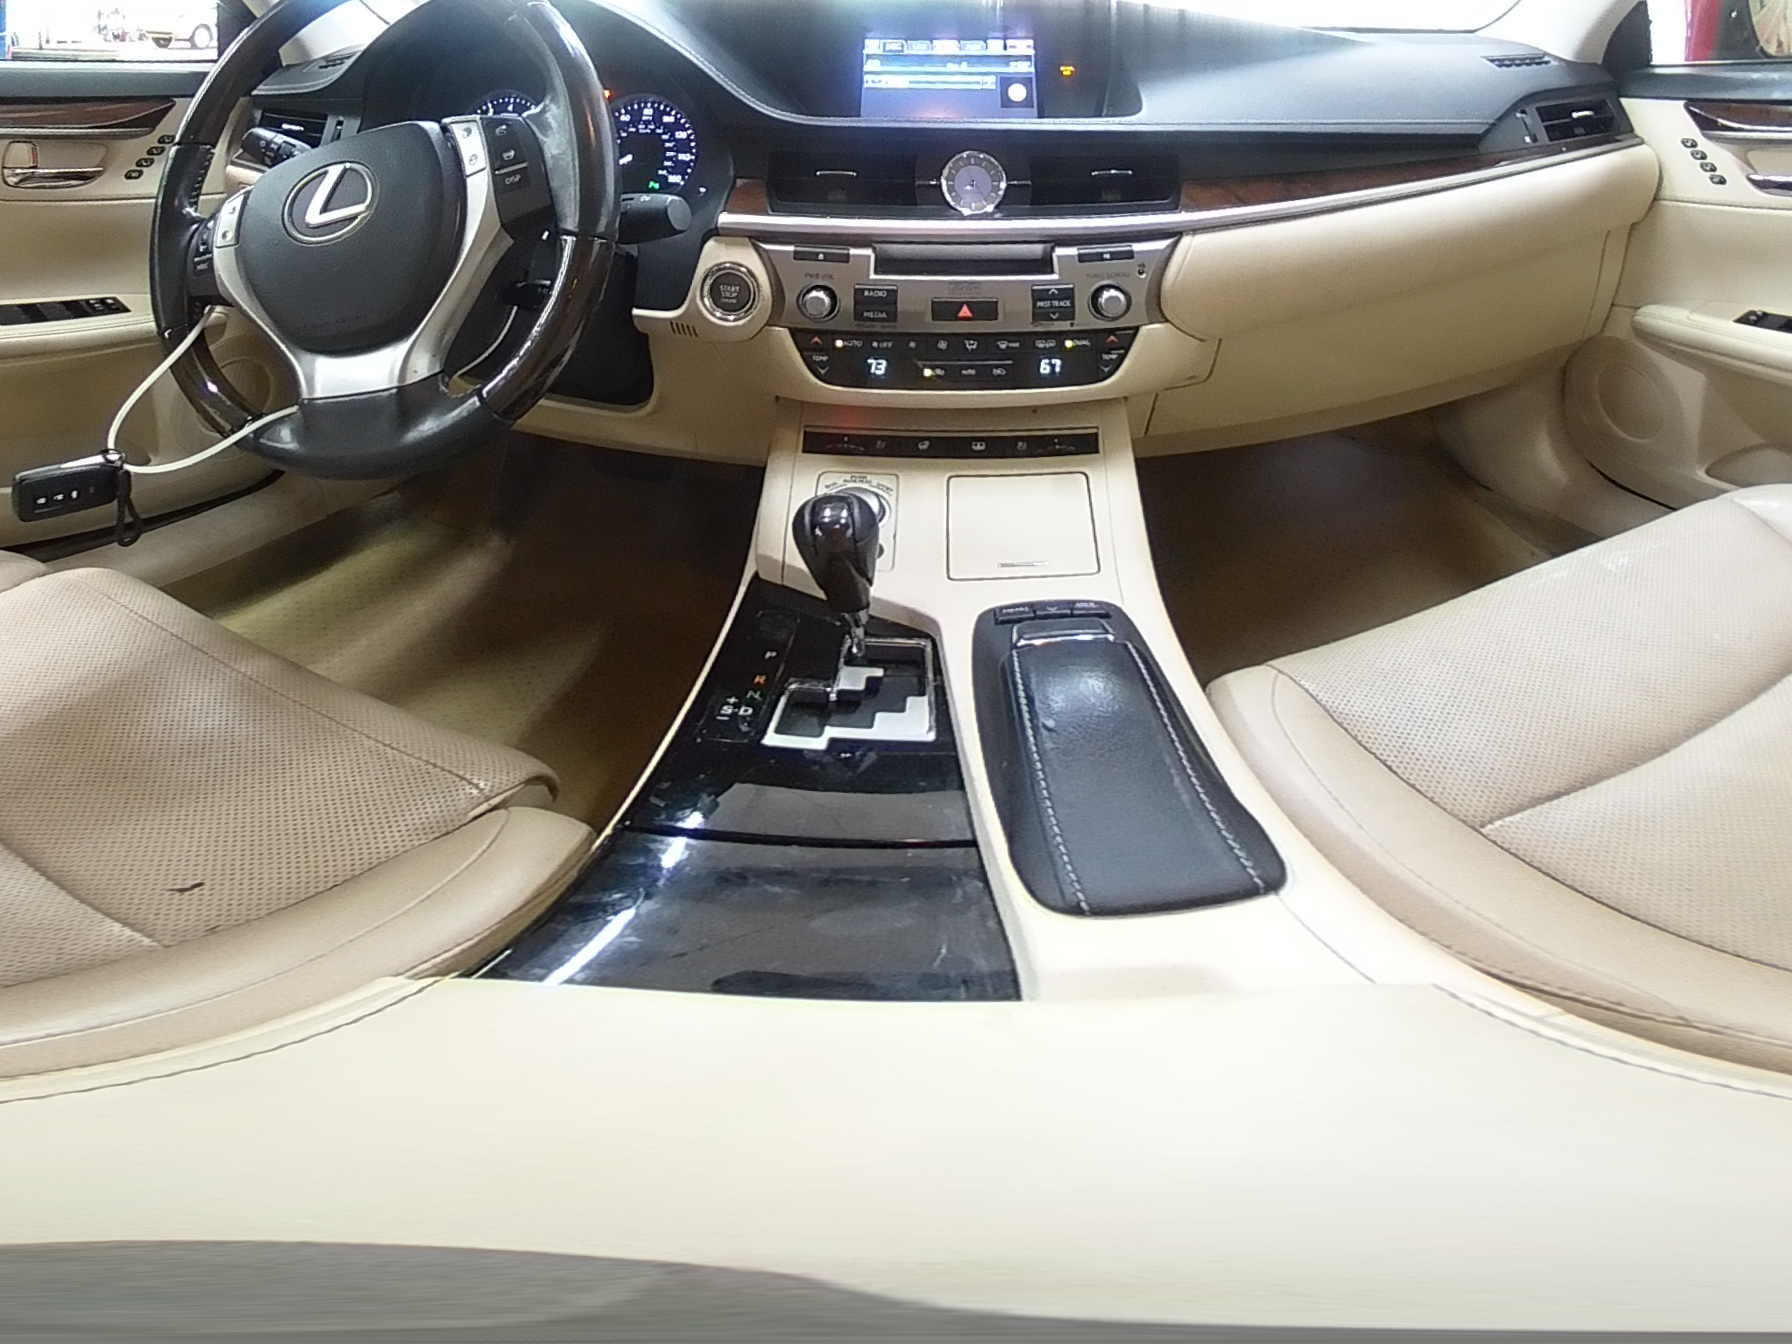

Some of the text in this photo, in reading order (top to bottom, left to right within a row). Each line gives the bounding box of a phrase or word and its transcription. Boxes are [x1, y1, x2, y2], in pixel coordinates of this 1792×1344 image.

[719, 284, 740, 292] START
[863, 290, 887, 298] RADIO
[863, 311, 887, 319] MEDIA
[843, 340, 863, 348] AUTO
[867, 358, 887, 375] 73
[1039, 358, 1062, 375] 67
[765, 651, 777, 659] P
[753, 675, 767, 685] R
[746, 690, 762, 701] N
